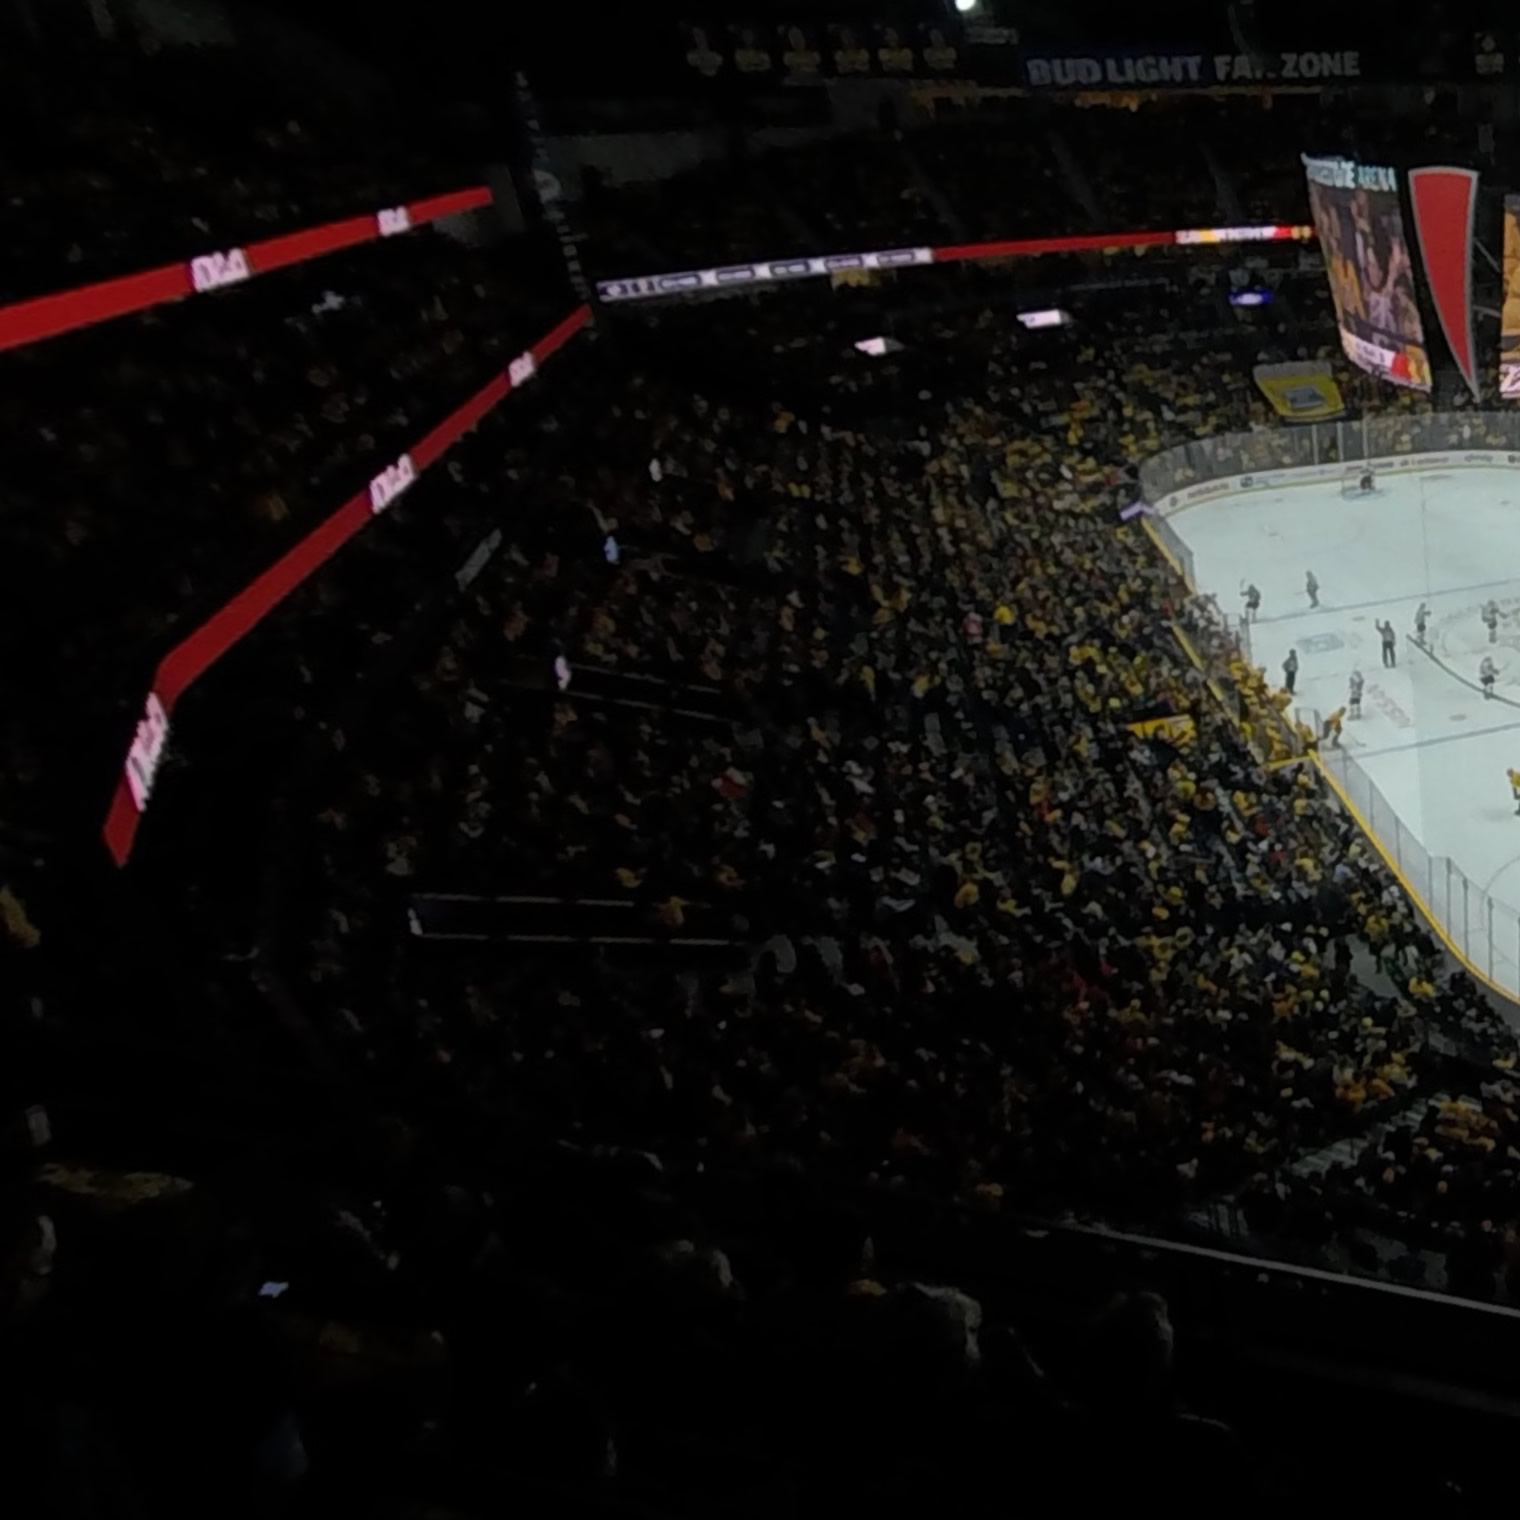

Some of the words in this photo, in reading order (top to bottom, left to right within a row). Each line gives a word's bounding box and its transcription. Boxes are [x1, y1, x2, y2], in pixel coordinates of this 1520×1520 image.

[1025, 57, 1104, 86] BUD
[1105, 54, 1203, 84] LIGHT
[1280, 51, 1361, 80] ZONE
